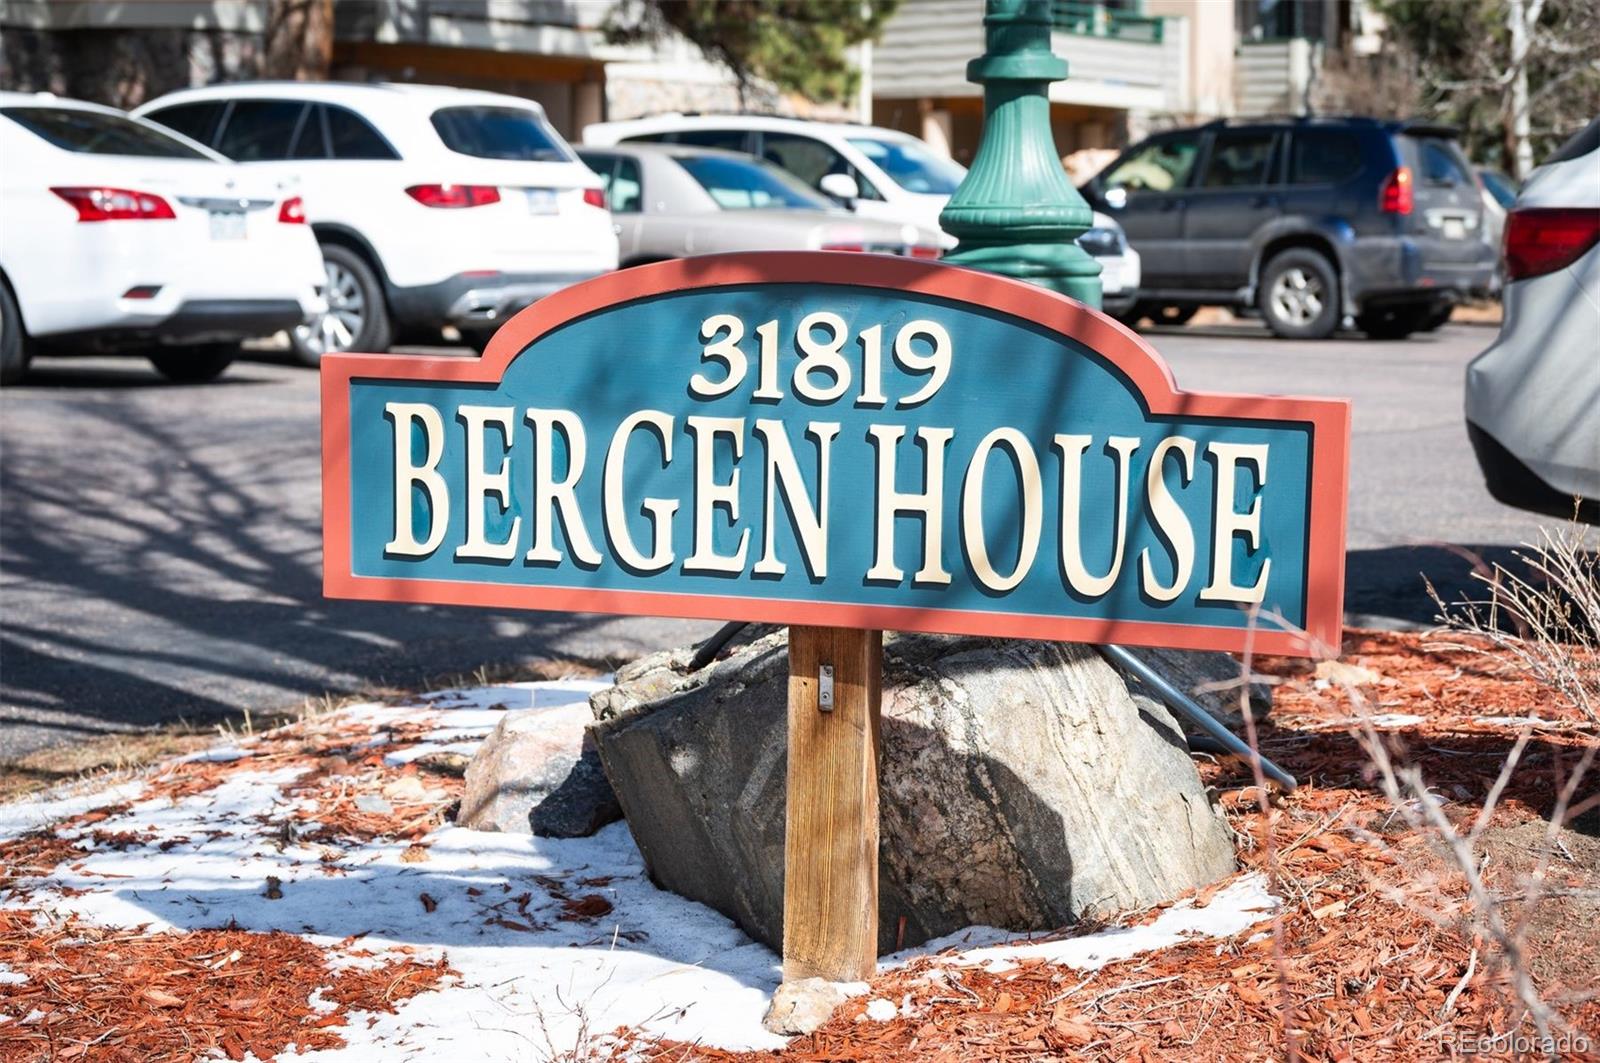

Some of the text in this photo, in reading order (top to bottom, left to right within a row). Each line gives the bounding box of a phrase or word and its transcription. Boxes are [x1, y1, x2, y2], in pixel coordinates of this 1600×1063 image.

[688, 312, 953, 405] 31819
[384, 402, 1272, 603] BERGEN HOUSE
